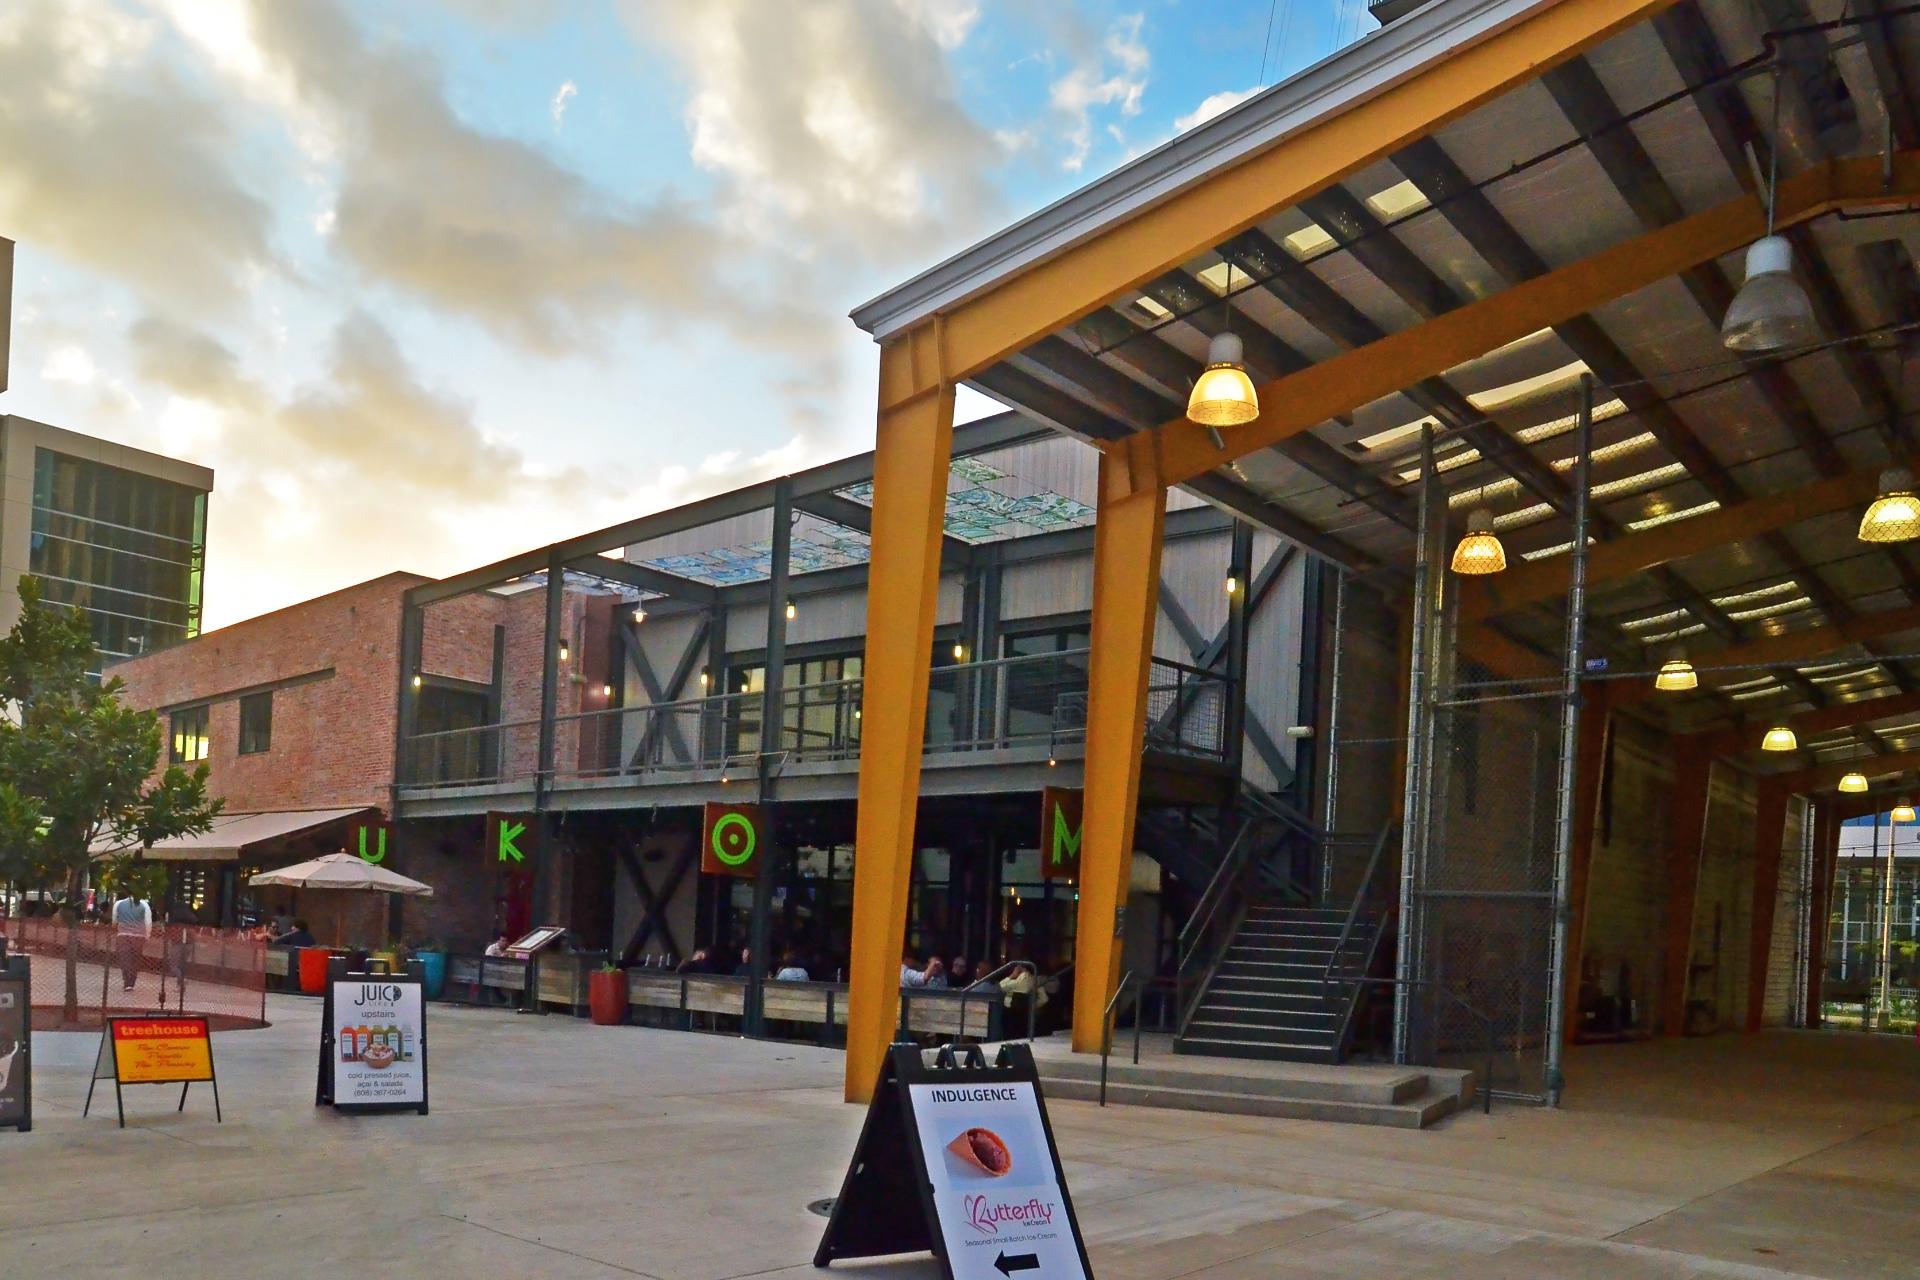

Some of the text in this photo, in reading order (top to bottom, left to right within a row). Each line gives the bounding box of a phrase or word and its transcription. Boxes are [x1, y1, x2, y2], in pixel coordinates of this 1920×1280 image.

[358, 825, 386, 866] U
[498, 819, 527, 863] K
[361, 1009, 396, 1019] upstairs
[120, 1023, 200, 1036] treehouse
[931, 1088, 1017, 1103] INDULGENCE
